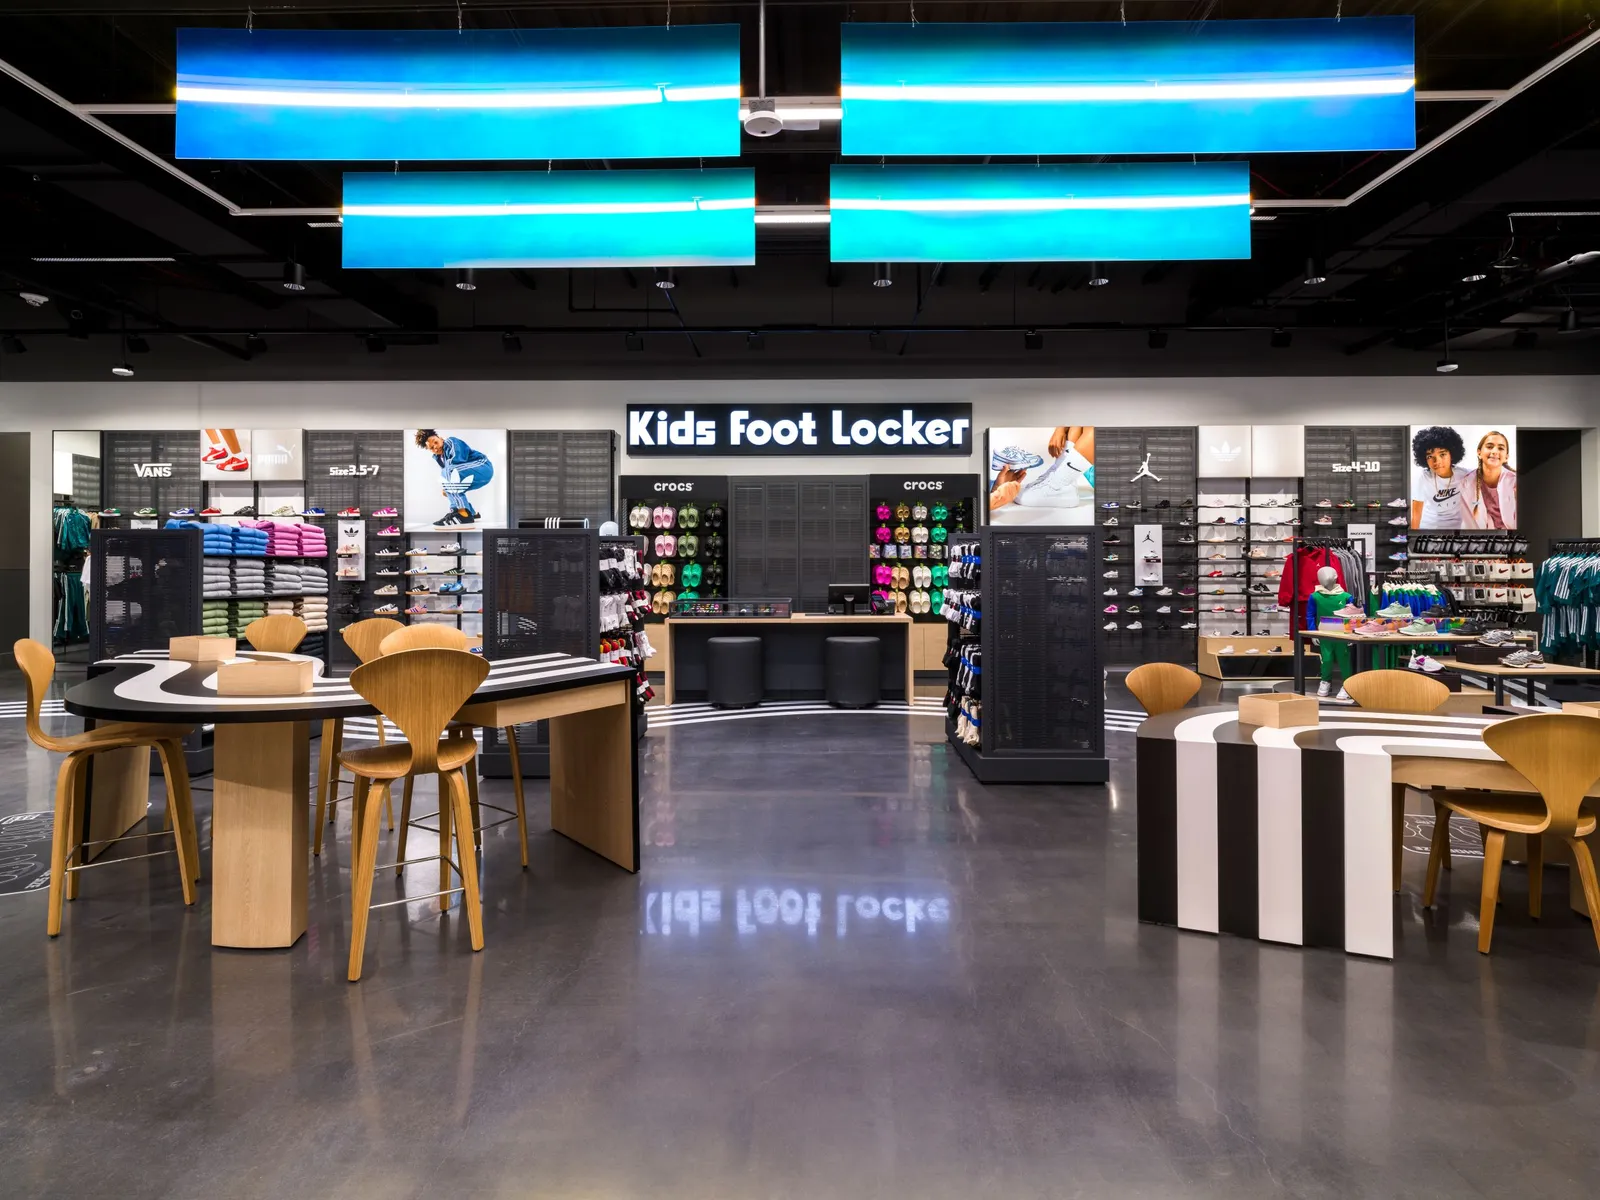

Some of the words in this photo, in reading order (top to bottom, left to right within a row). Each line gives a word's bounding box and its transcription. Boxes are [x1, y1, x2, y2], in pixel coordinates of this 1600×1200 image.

[629, 410, 716, 446] Kids
[730, 410, 818, 446] Foot
[832, 409, 970, 446] Locker
[133, 463, 172, 478] VANS
[653, 481, 694, 492] crocs
[903, 479, 944, 491] crocs
[1436, 487, 1457, 498] NIKE
